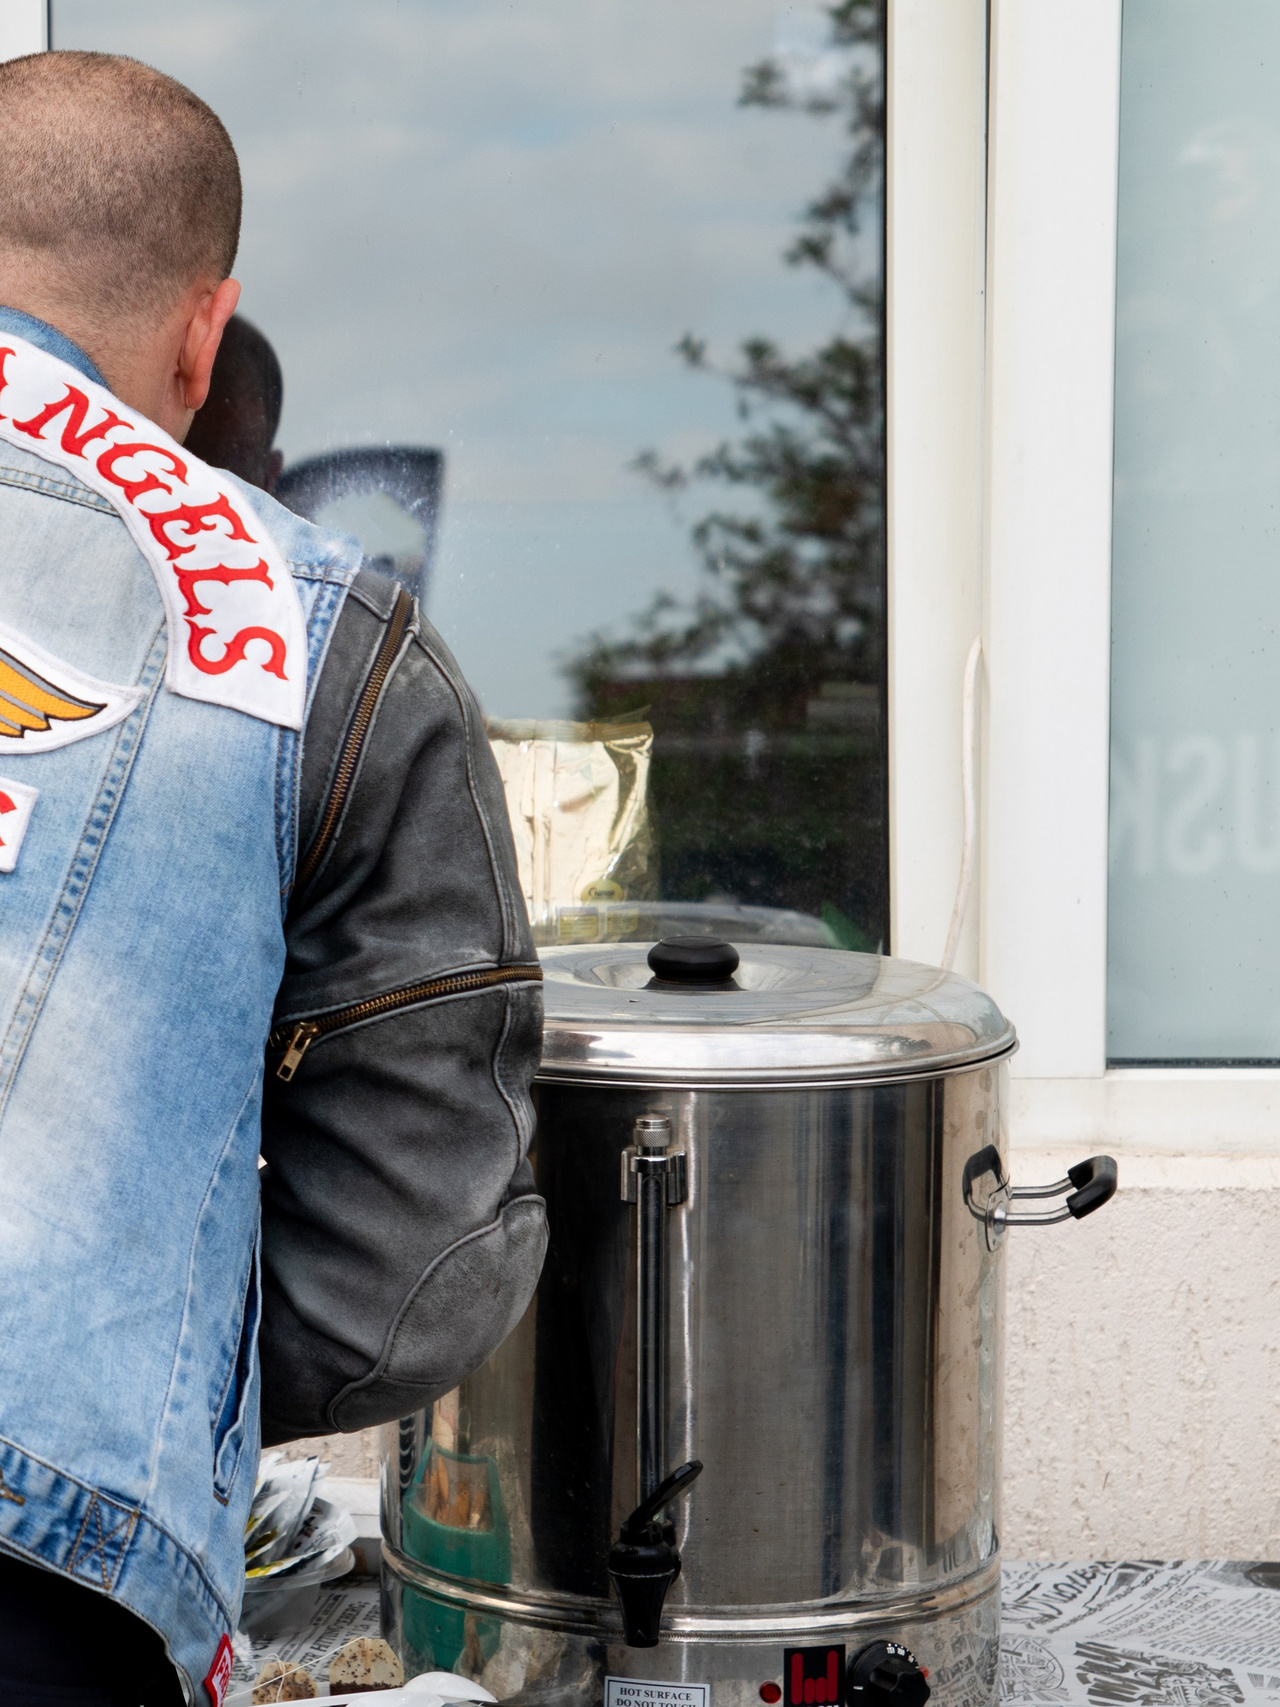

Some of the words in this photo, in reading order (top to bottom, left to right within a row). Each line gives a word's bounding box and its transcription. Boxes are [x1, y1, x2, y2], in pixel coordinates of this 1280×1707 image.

[620, 1687, 642, 1697] HOT
[644, 1689, 692, 1701] SURFACE
[616, 1698, 632, 1707] DO
